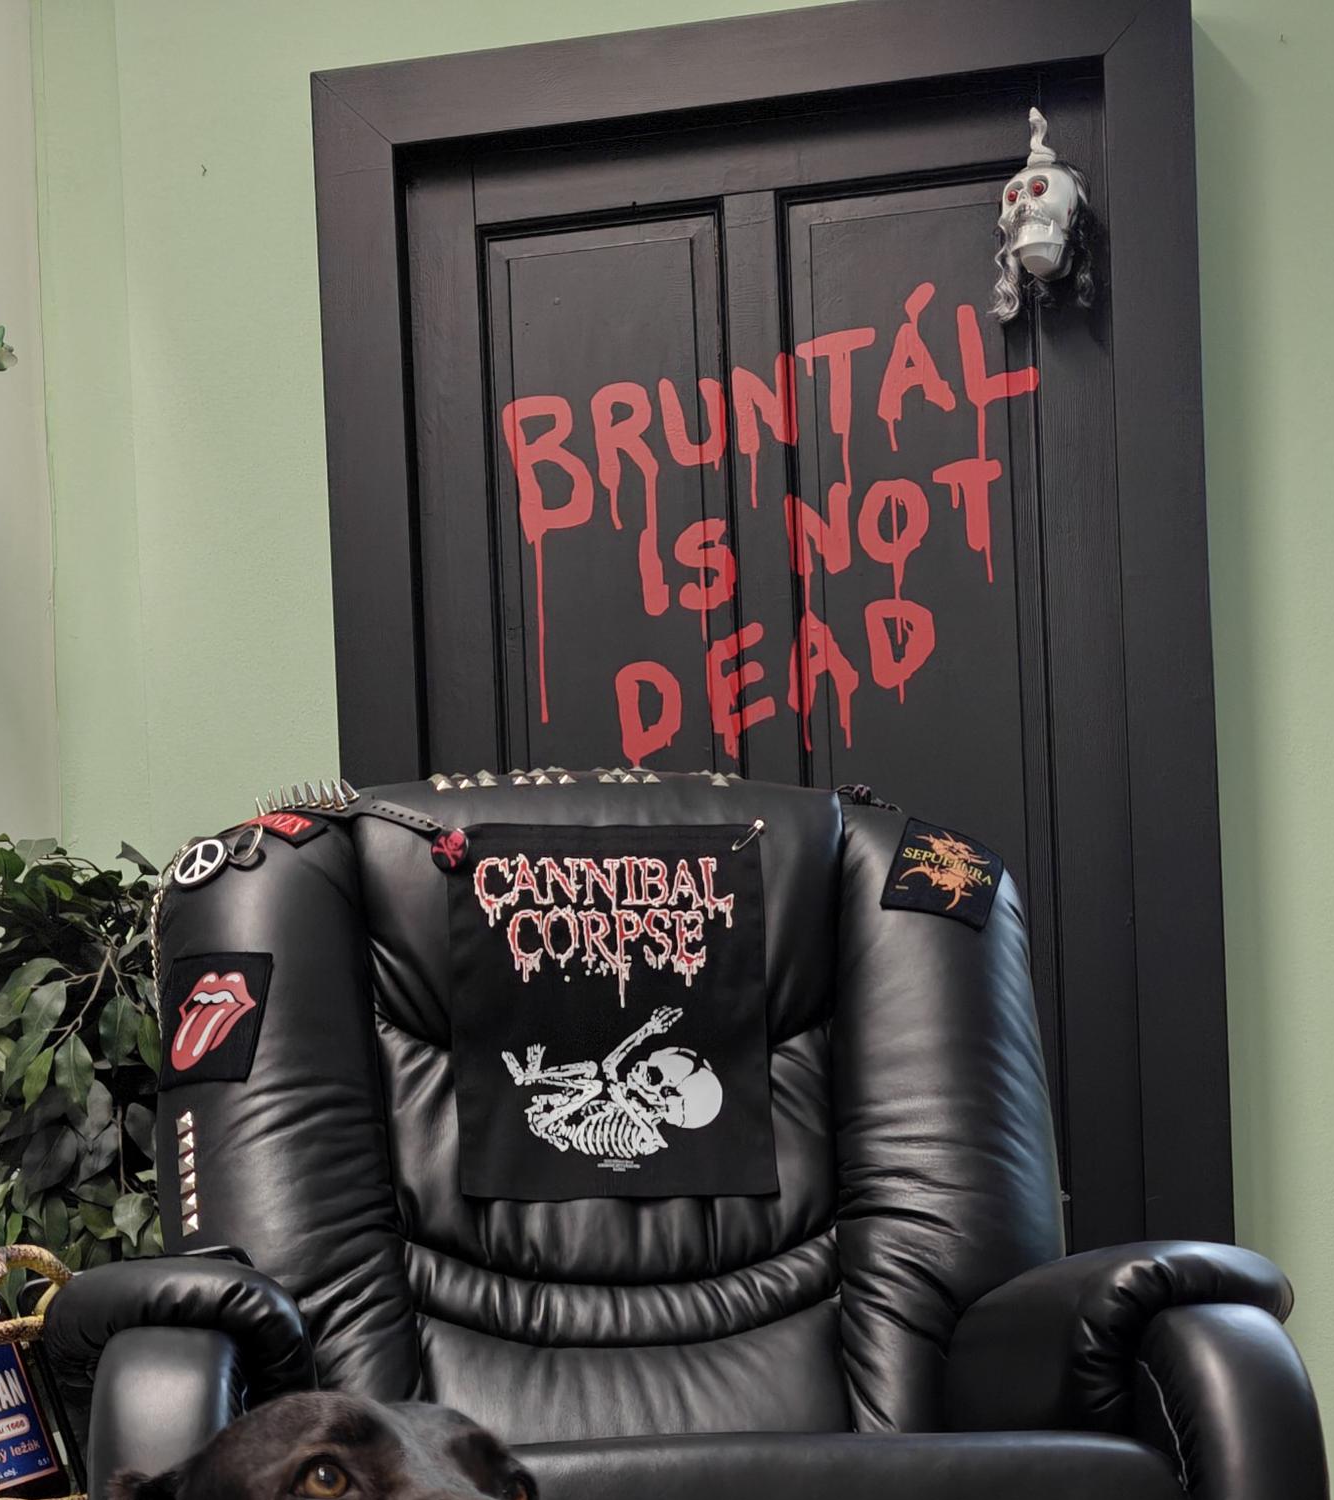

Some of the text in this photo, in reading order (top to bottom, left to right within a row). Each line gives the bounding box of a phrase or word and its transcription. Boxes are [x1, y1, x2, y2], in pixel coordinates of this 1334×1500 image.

[501, 282, 1039, 580] BRUNTÁL
[638, 457, 1002, 616] IS NOT
[613, 598, 936, 762] DEAD
[473, 853, 734, 920] CANNIBAL
[507, 906, 708, 988] CORPSE
[9, 1439, 41, 1457] ležák
